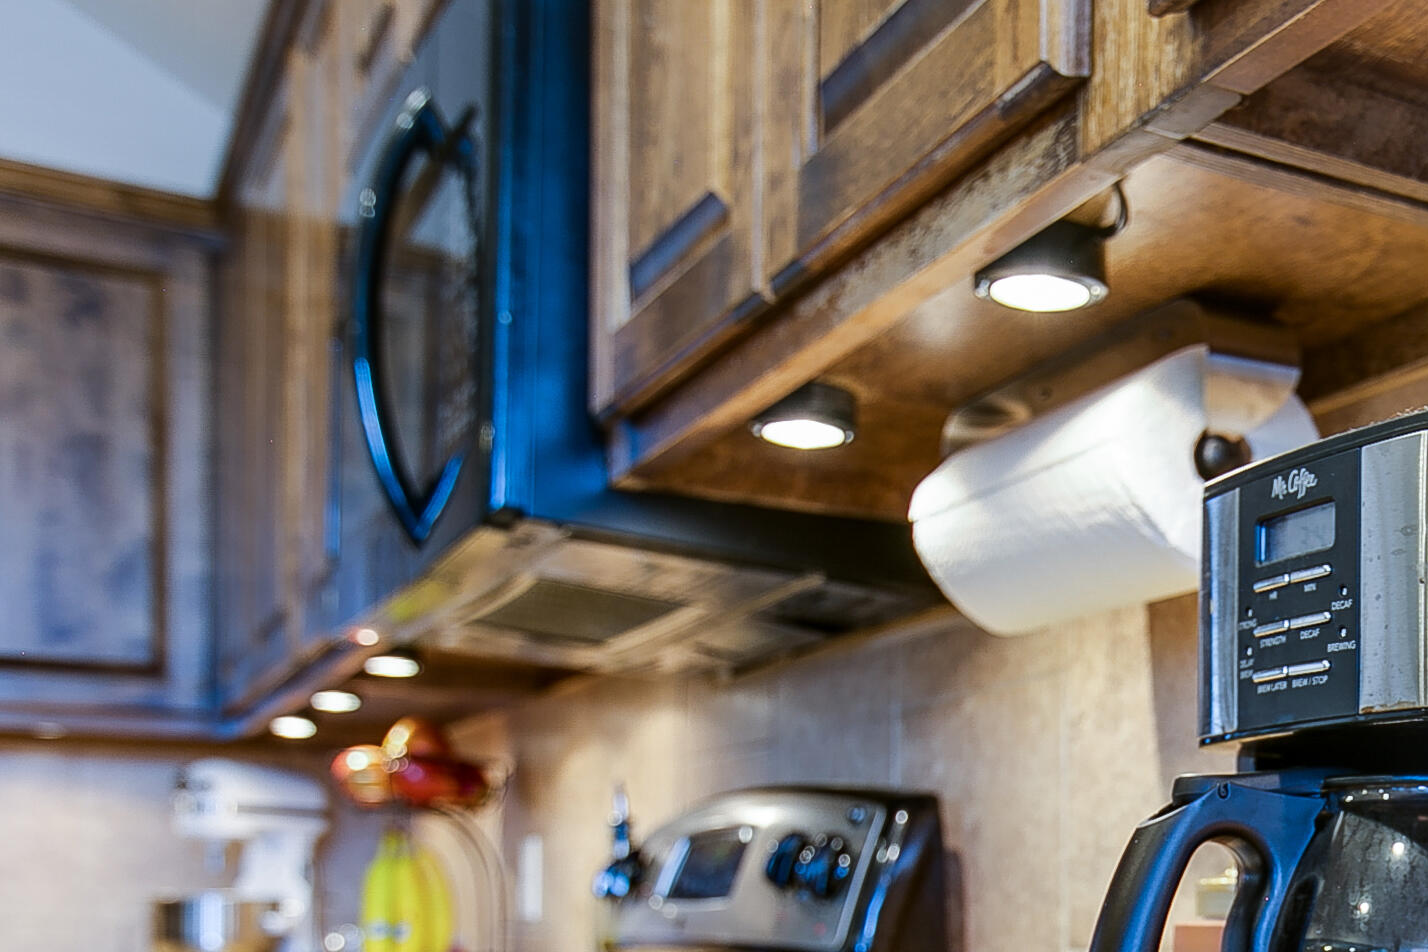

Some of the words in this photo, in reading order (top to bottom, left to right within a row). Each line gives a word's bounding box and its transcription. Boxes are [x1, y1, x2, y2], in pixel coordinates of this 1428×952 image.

[1288, 467, 1318, 500] Coffee
[1331, 599, 1353, 611] DECAF
[1300, 628, 1321, 640] DECAF
[1327, 640, 1357, 653] BREWING
